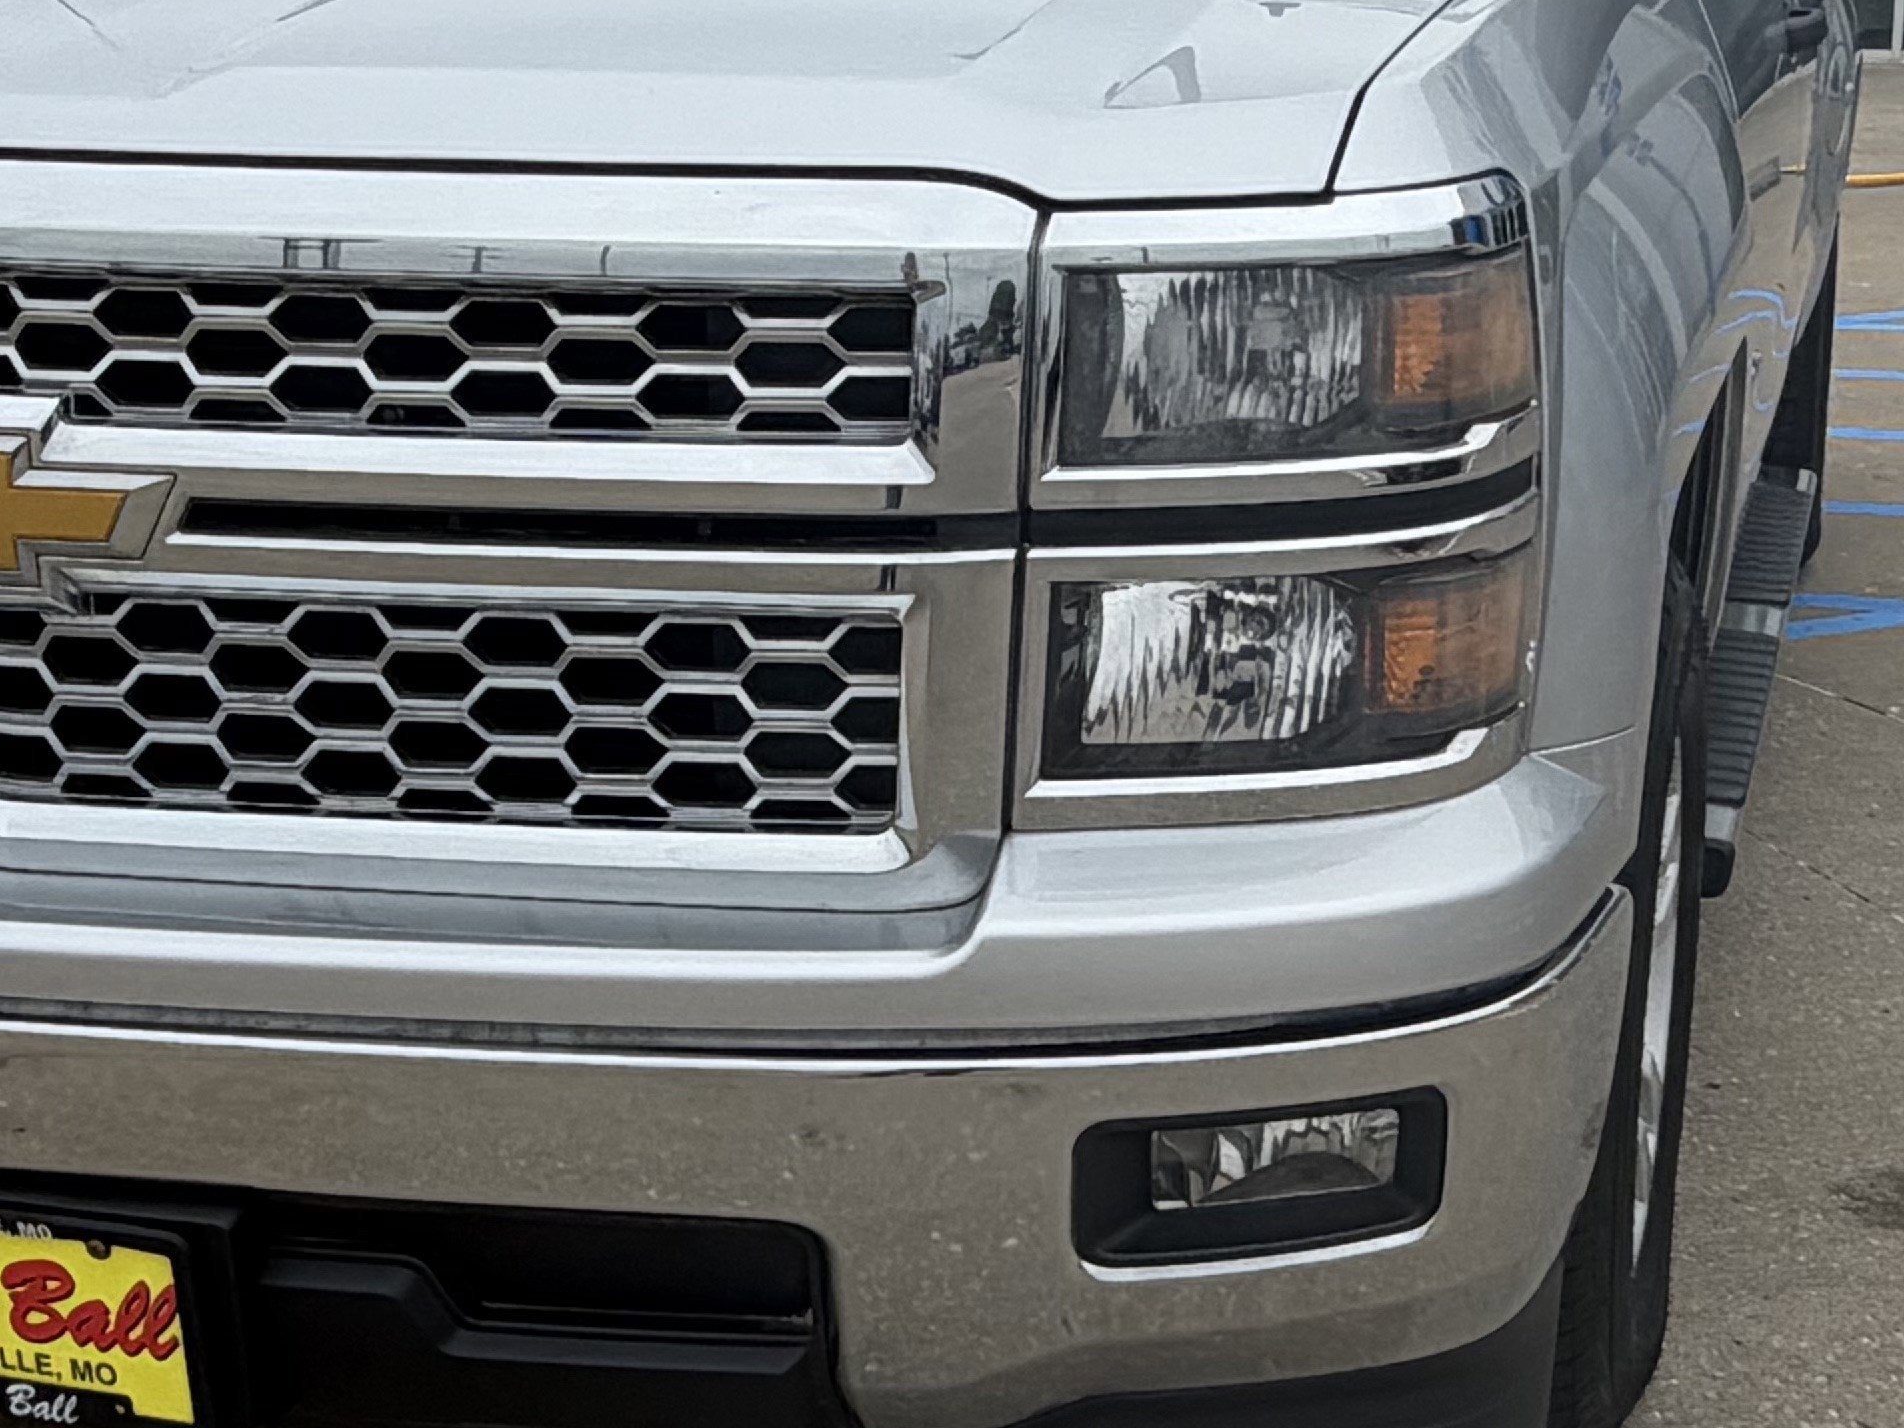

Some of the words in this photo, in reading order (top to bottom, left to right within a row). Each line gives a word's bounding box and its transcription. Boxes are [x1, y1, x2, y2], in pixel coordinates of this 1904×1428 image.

[0, 1258, 180, 1360] Ball
[70, 1358, 118, 1387] MO
[5, 1383, 80, 1424] Ball
